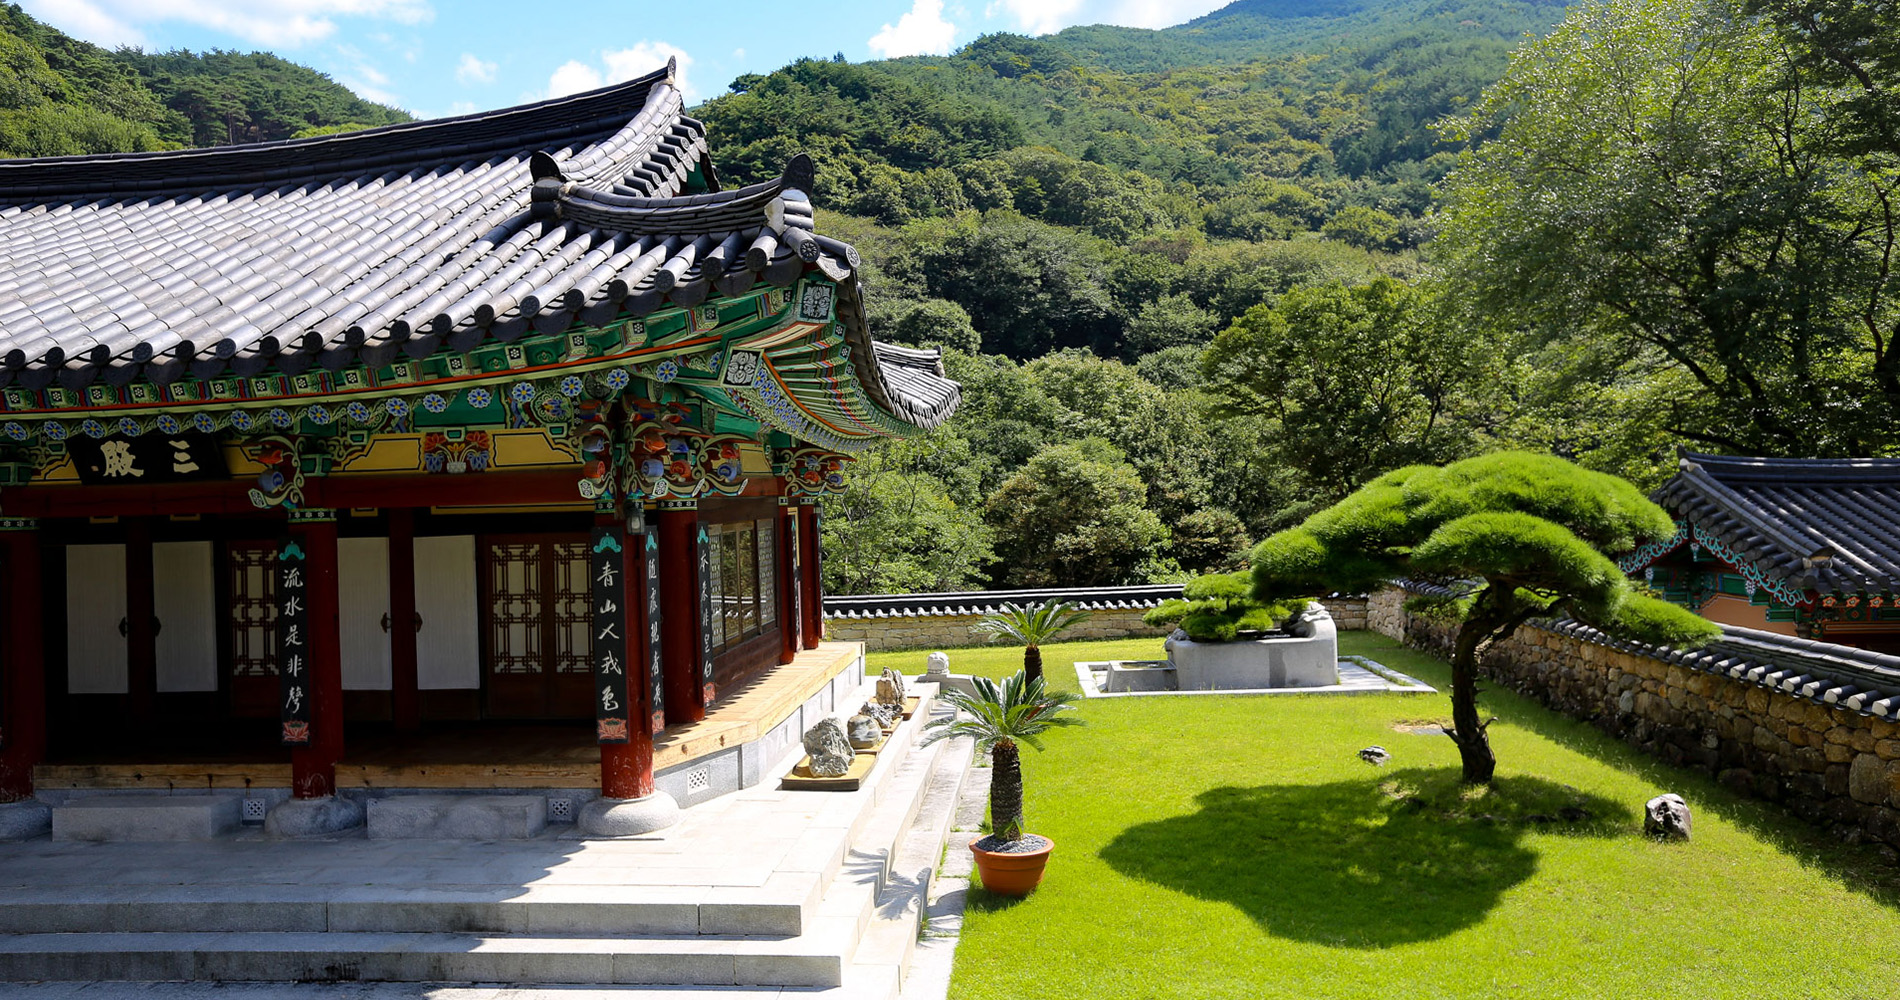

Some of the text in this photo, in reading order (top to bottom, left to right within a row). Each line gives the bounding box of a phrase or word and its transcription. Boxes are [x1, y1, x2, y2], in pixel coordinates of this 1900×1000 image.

[282, 566, 304, 714] 流水是非聲
[596, 559, 622, 712] 青山人我色
